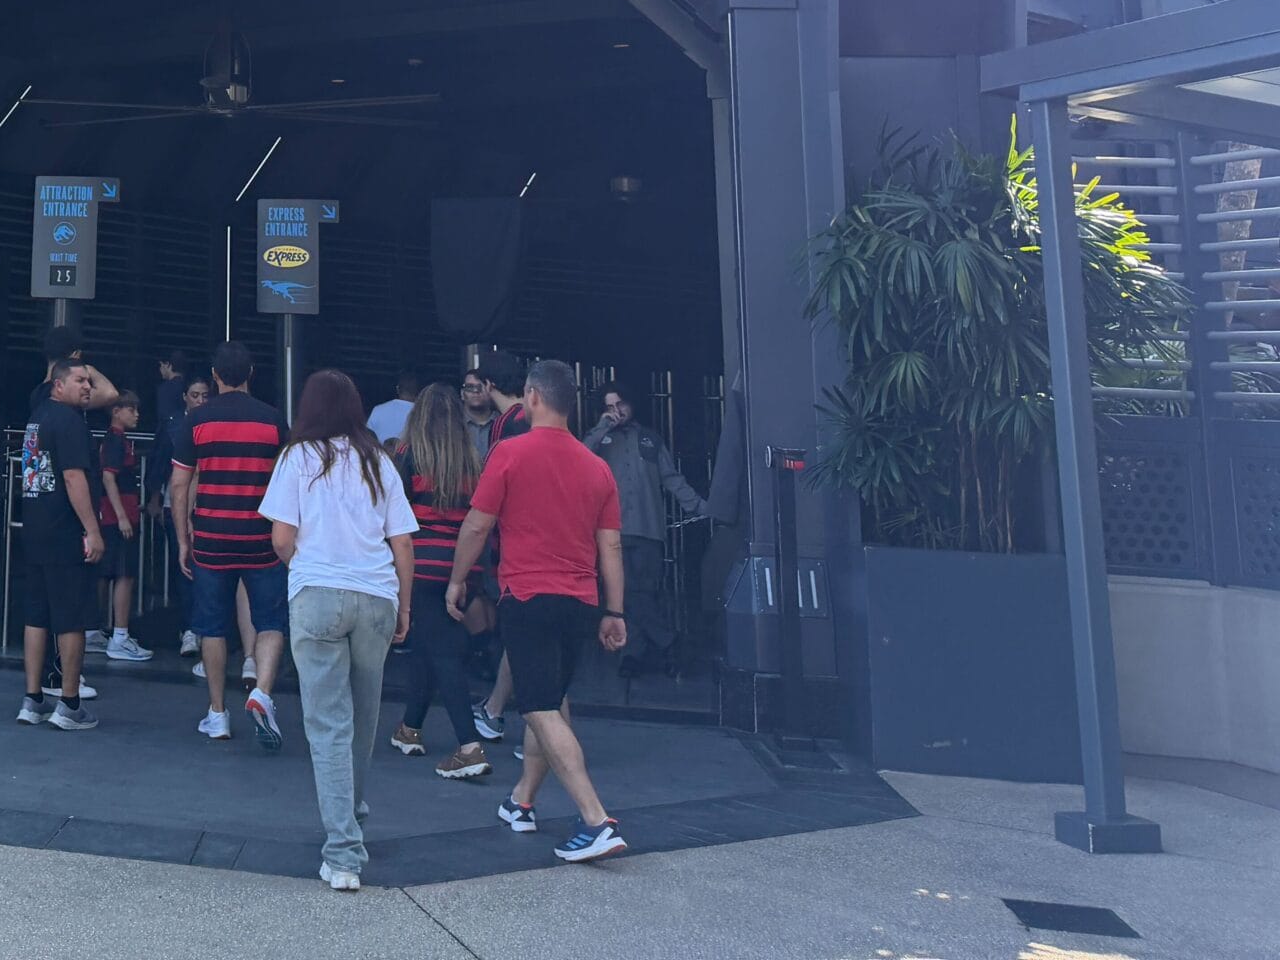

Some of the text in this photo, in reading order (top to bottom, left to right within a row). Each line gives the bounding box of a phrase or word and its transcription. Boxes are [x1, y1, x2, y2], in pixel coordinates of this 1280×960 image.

[40, 185, 94, 201] ATTRACTION
[43, 201, 89, 217] ENTRANCE
[268, 207, 305, 221] EXPRESS
[264, 222, 308, 237] ENTRANCE
[266, 250, 308, 266] EXPRESS
[56, 269, 71, 283] 25
